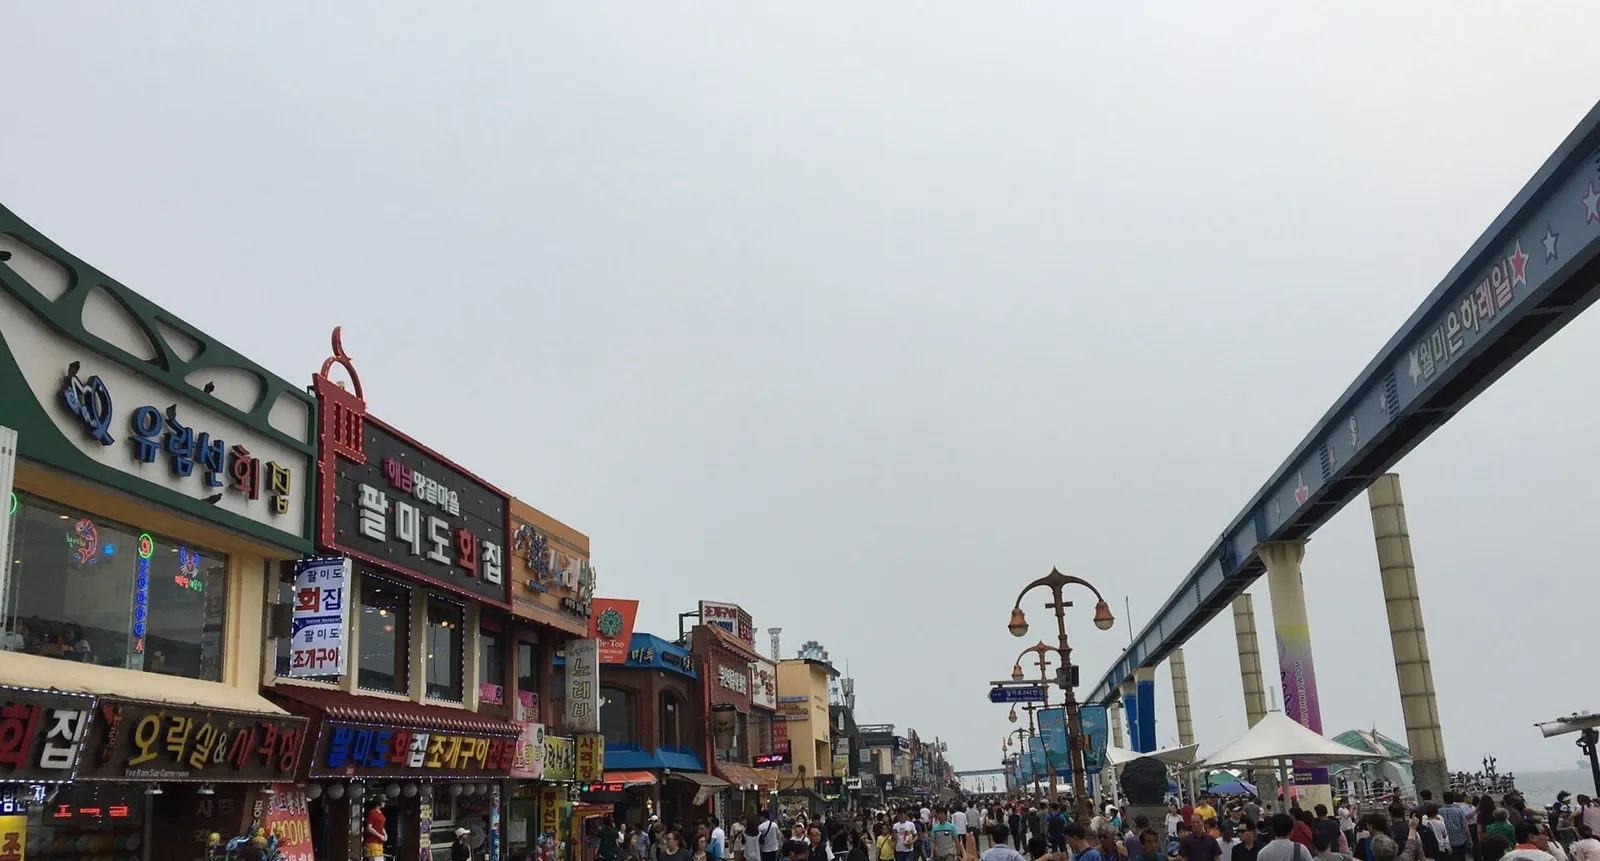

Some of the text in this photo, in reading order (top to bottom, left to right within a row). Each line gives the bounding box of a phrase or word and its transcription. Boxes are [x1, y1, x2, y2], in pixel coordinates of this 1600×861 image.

[1420, 259, 1513, 379] 월미은하레일
[307, 568, 343, 583] 팔미도
[295, 586, 342, 613] 회집
[304, 628, 340, 643] 팔미도
[293, 647, 340, 669] 조개구이
[572, 657, 592, 726] 노래방
[580, 738, 594, 778] 사격장
